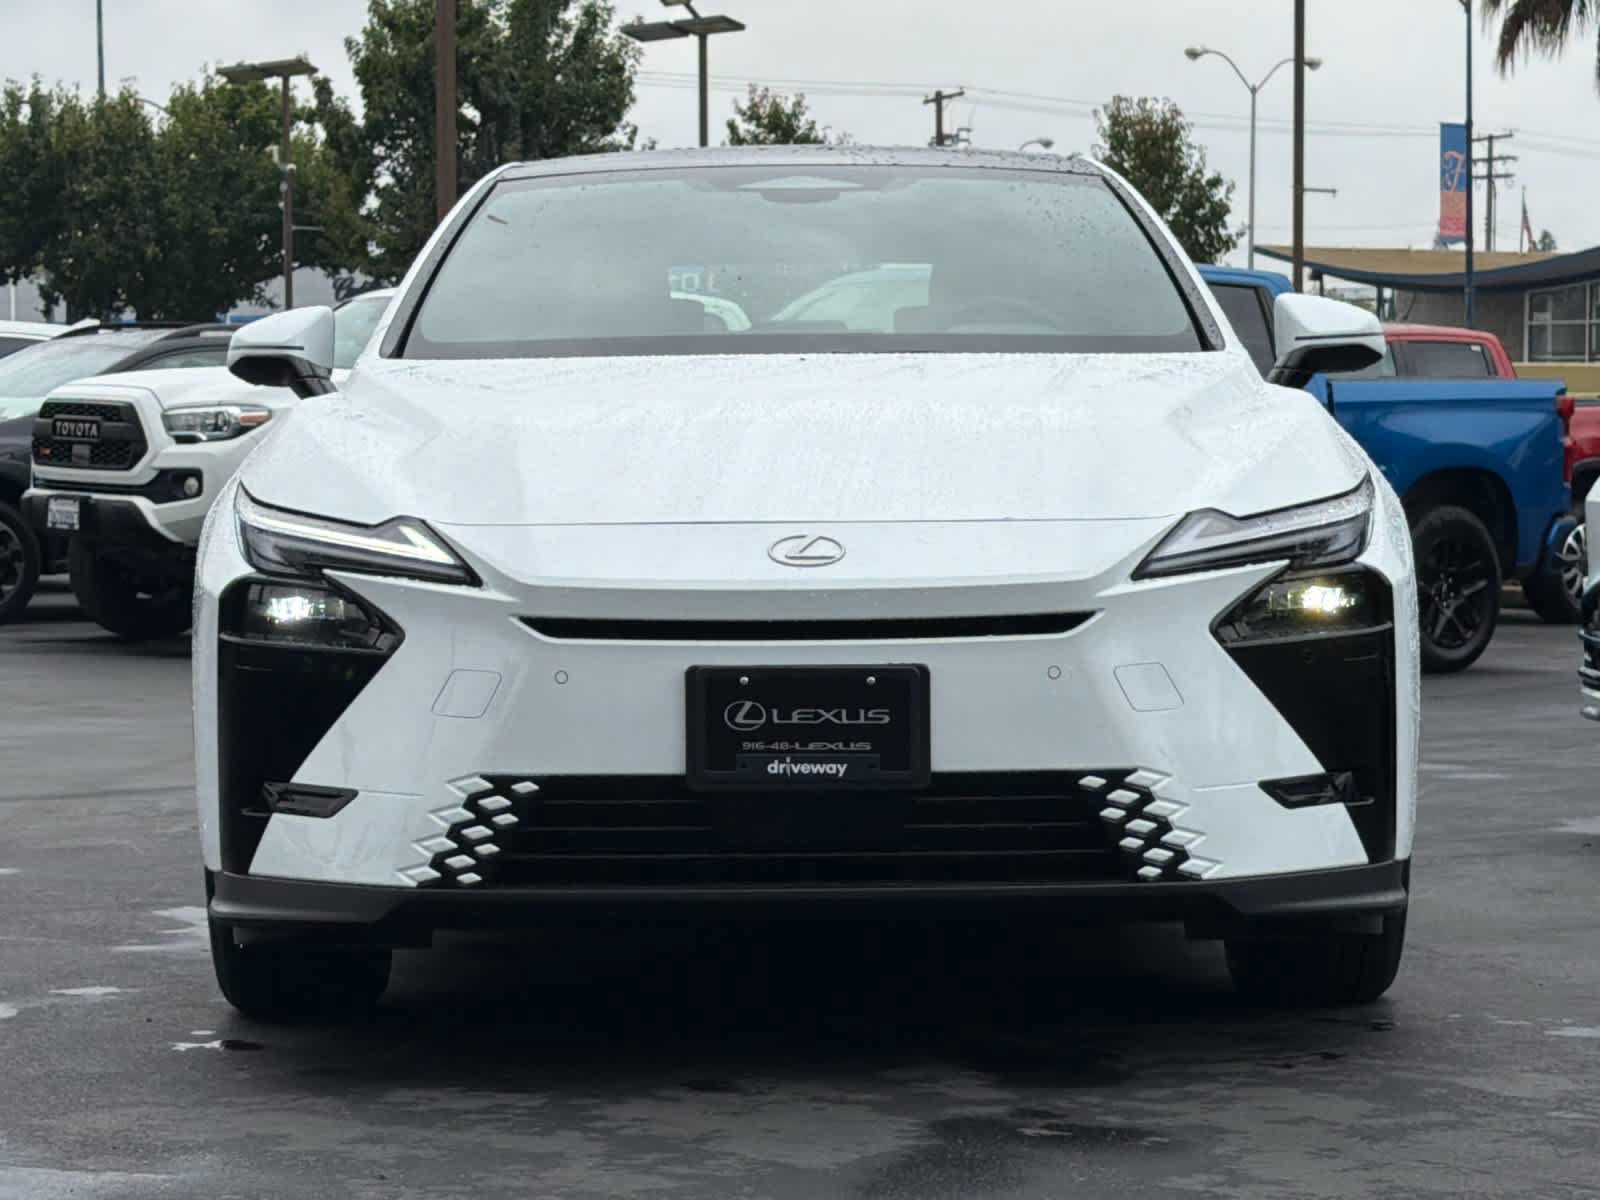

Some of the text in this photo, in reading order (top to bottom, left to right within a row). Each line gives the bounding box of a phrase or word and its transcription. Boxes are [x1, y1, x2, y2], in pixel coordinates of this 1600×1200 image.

[55, 421, 98, 437] TOYOTA
[771, 708, 891, 724] LEXUS
[767, 756, 848, 777] driveway
